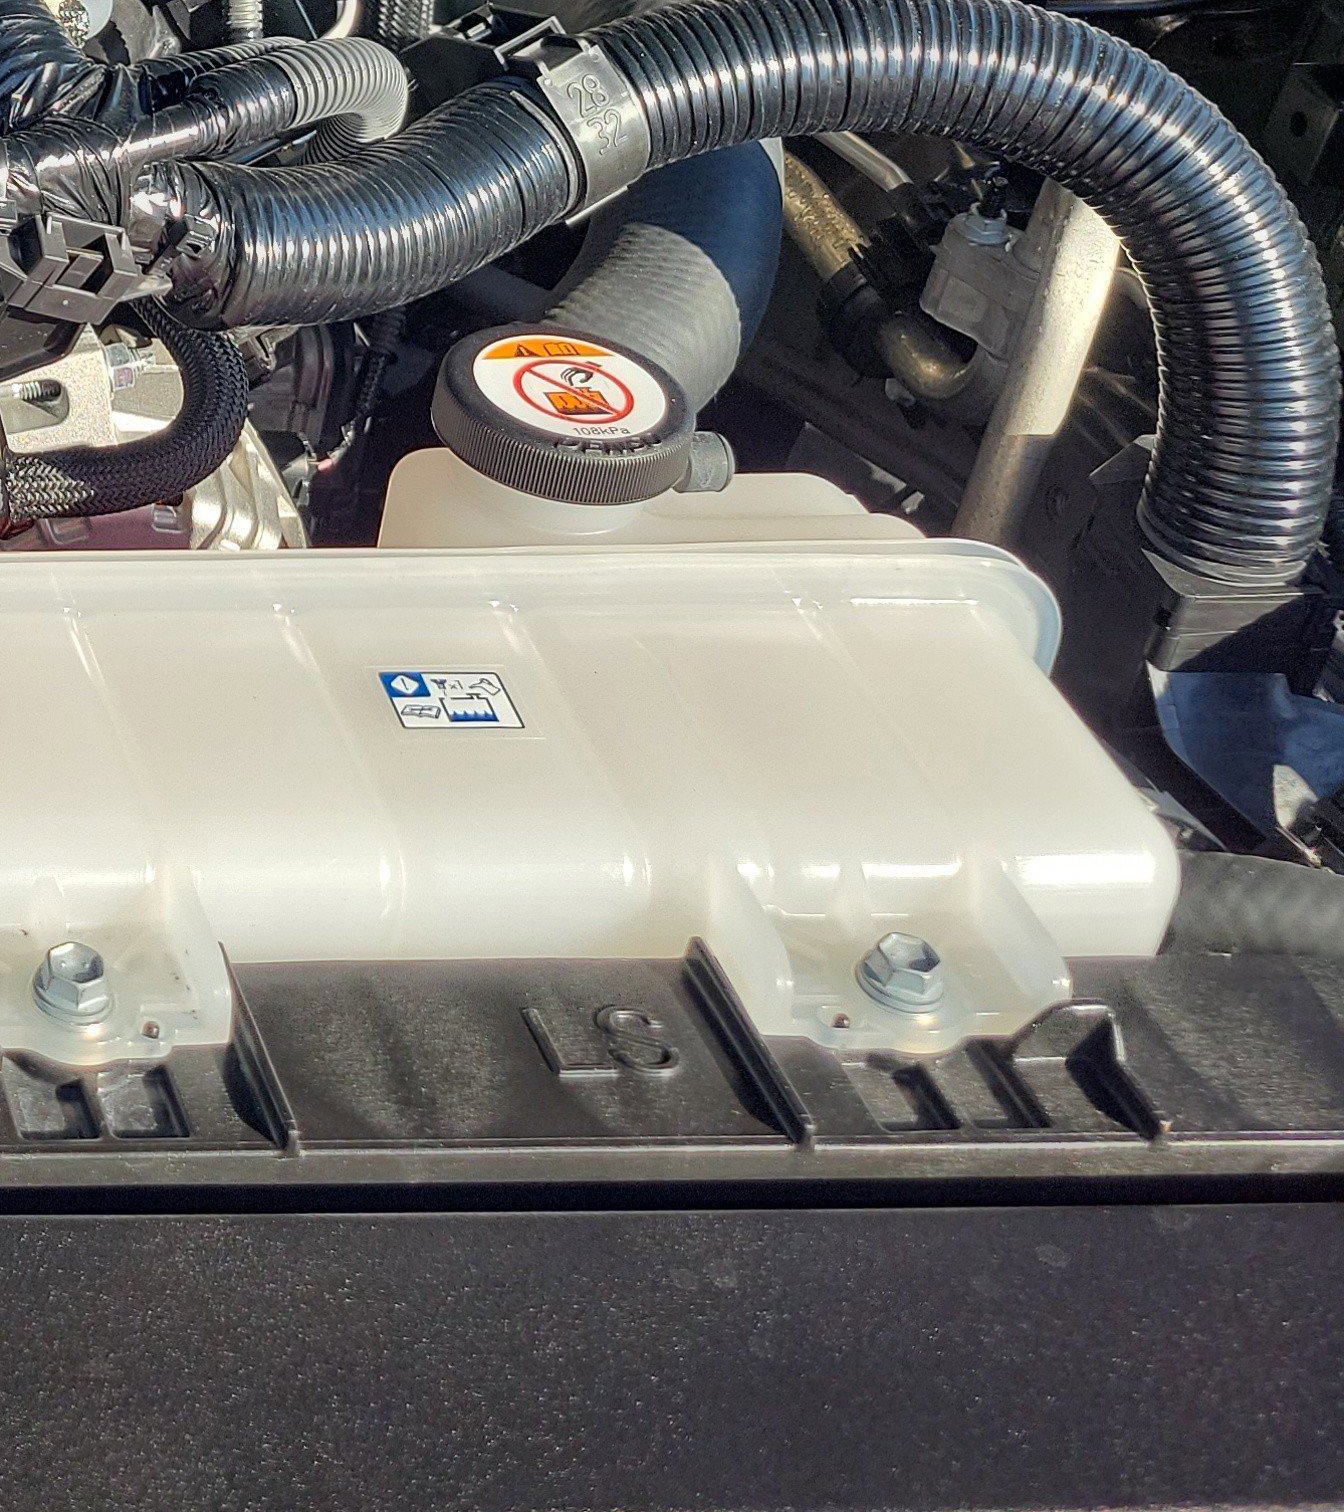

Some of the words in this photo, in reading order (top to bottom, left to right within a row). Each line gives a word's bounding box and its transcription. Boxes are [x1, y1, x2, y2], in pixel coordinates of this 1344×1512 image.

[566, 74, 611, 119] 28
[586, 109, 628, 156] 32
[572, 426, 631, 436] 108kPa
[521, 1003, 680, 1078] LS
